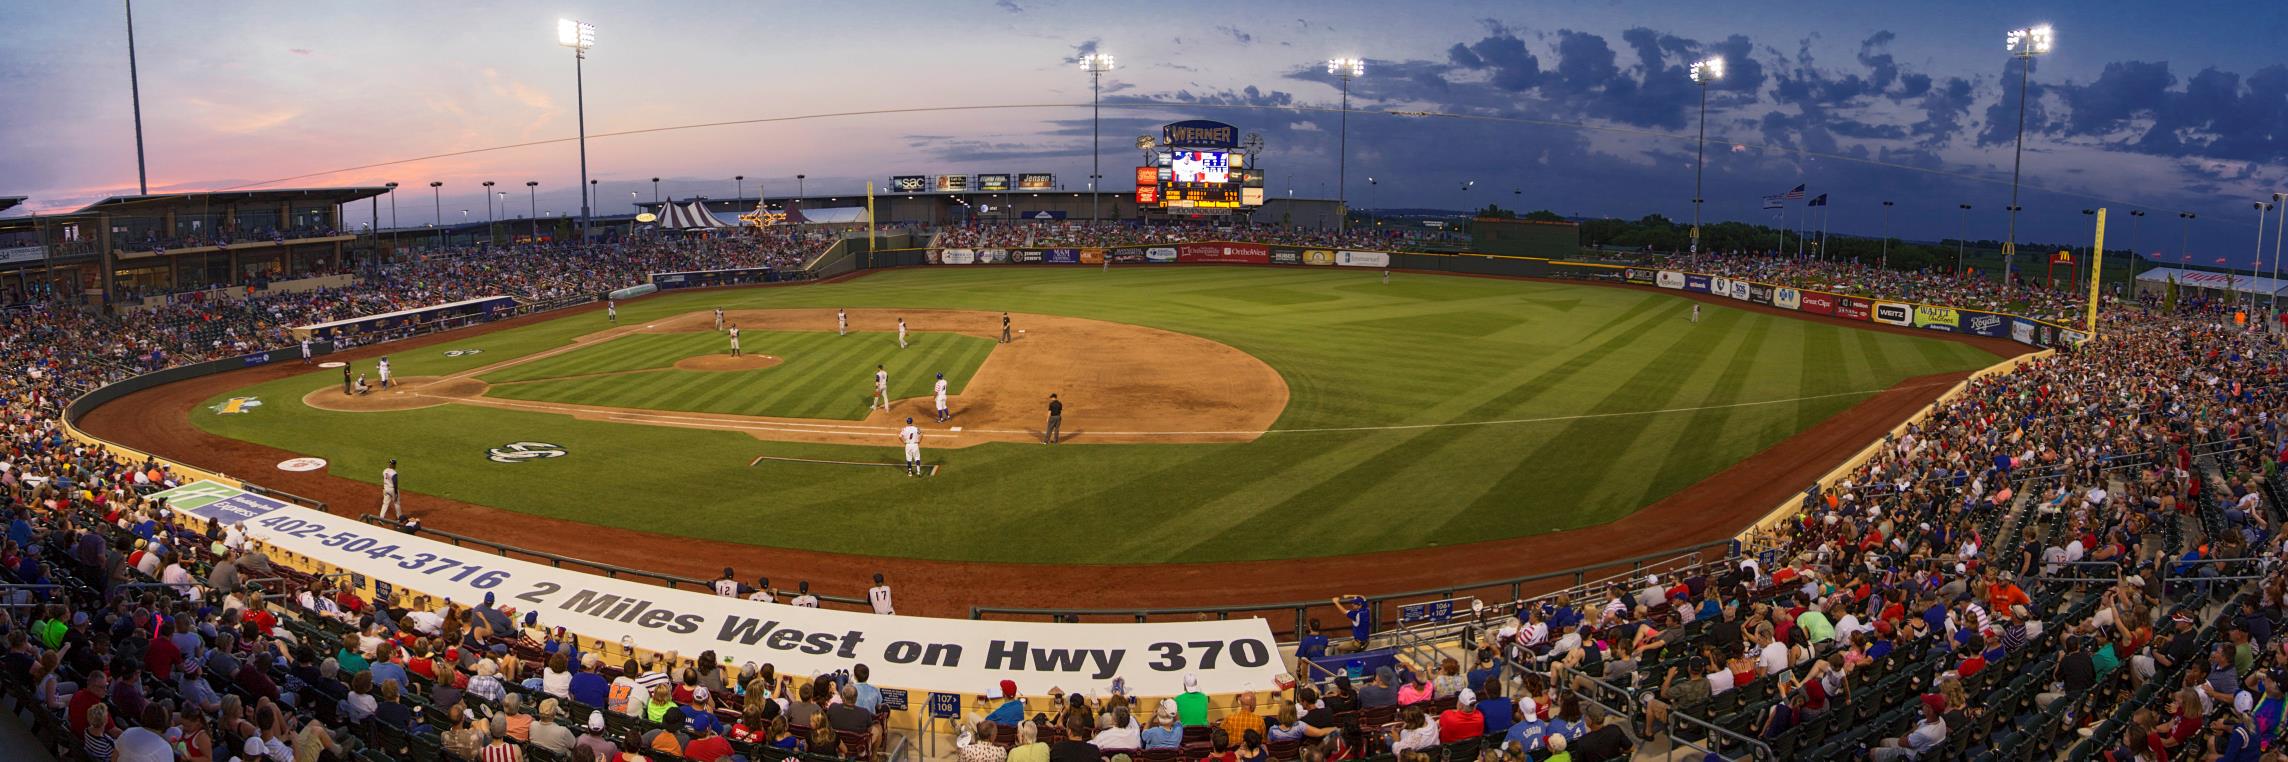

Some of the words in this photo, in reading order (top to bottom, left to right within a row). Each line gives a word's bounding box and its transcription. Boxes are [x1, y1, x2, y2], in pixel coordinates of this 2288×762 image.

[1172, 126, 1231, 142] WERNER
[902, 178, 925, 188] sac
[1024, 175, 1051, 183] Jensen
[1802, 296, 1817, 305] Great
[1880, 309, 1904, 318] WEITZ
[1970, 315, 2001, 331] Royals
[213, 501, 258, 517] Express
[719, 585, 731, 596] 12
[259, 515, 512, 590] 402-504-3716
[515, 581, 562, 603] 2
[558, 589, 704, 634] Miles
[716, 614, 865, 659] West
[883, 640, 963, 667] on
[984, 640, 1127, 680] Hwy
[1147, 638, 1270, 671] 370
[875, 590, 887, 602] 17
[937, 694, 953, 703] 107
[938, 703, 953, 712] 108
